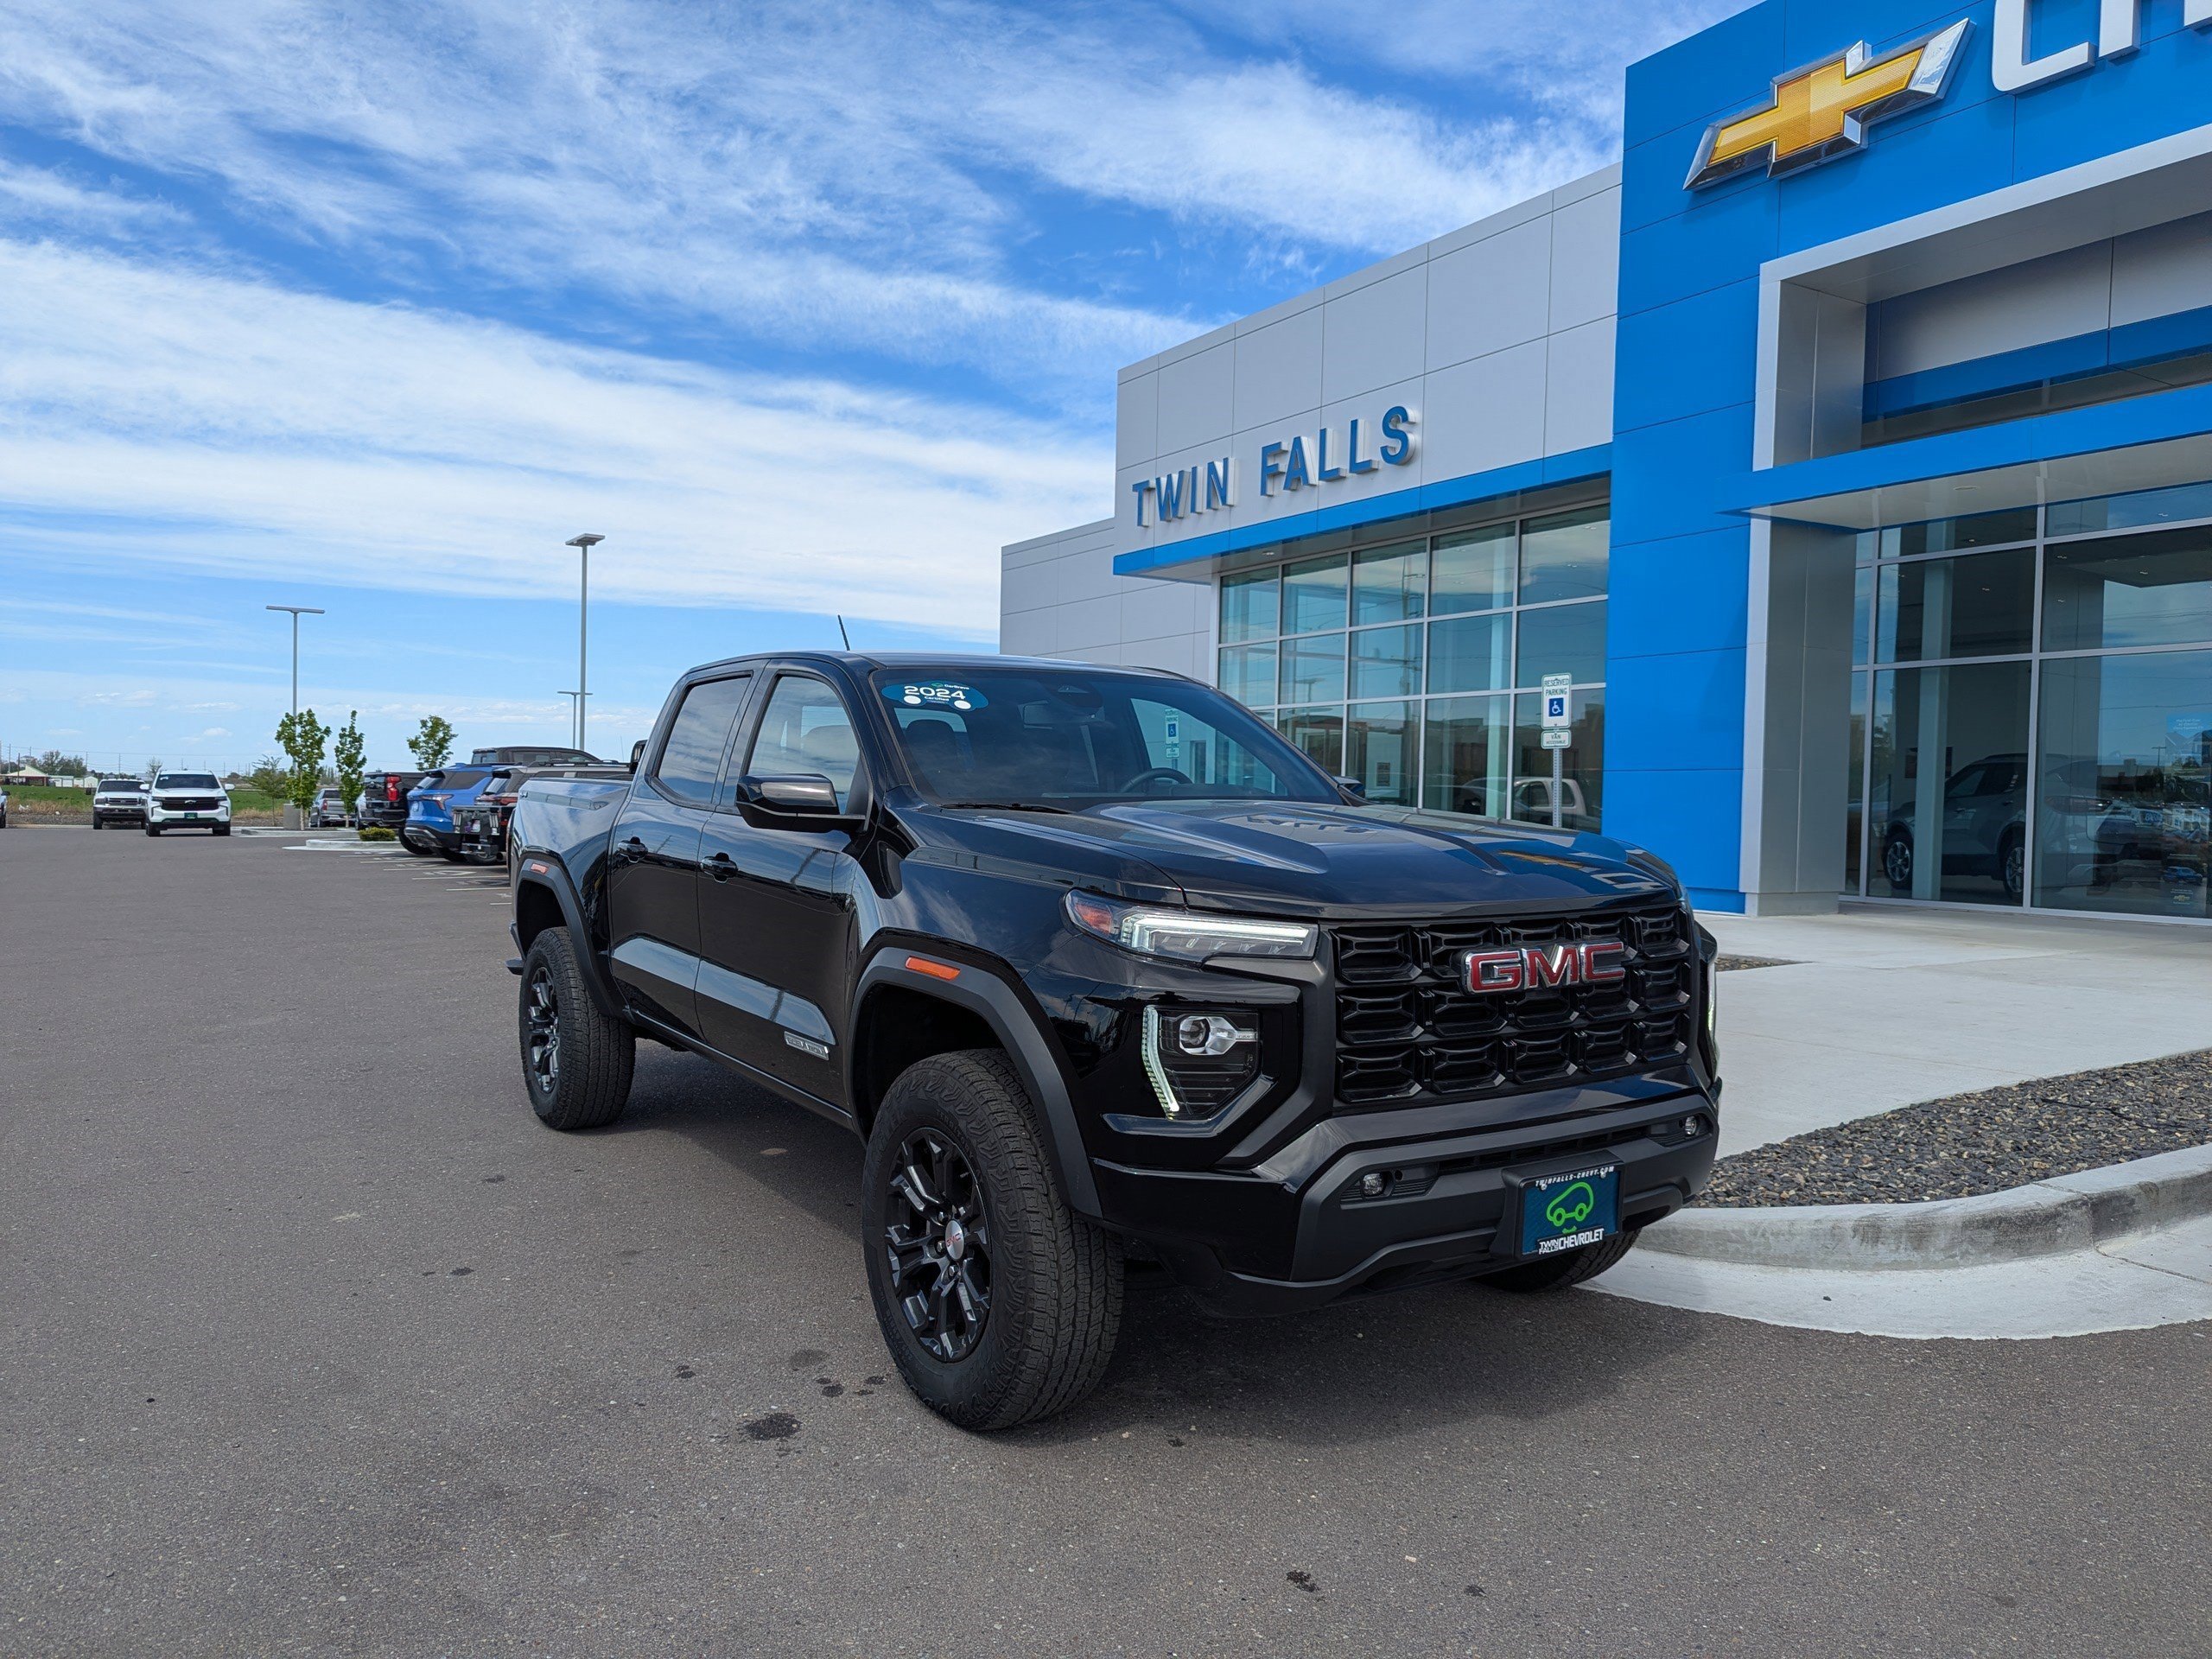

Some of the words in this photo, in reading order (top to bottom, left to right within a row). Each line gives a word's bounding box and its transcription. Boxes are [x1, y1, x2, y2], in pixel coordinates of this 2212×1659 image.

[1132, 457, 1236, 528] TWIN
[1260, 405, 1417, 497] FALLS
[904, 685, 966, 699] 2024
[1465, 941, 1626, 994] GMC
[946, 1232, 962, 1248] GMC
[1539, 1241, 1560, 1249] TWIN
[1558, 1228, 1605, 1250] CHEVROLET
[1538, 1244, 1560, 1255] FALLS
